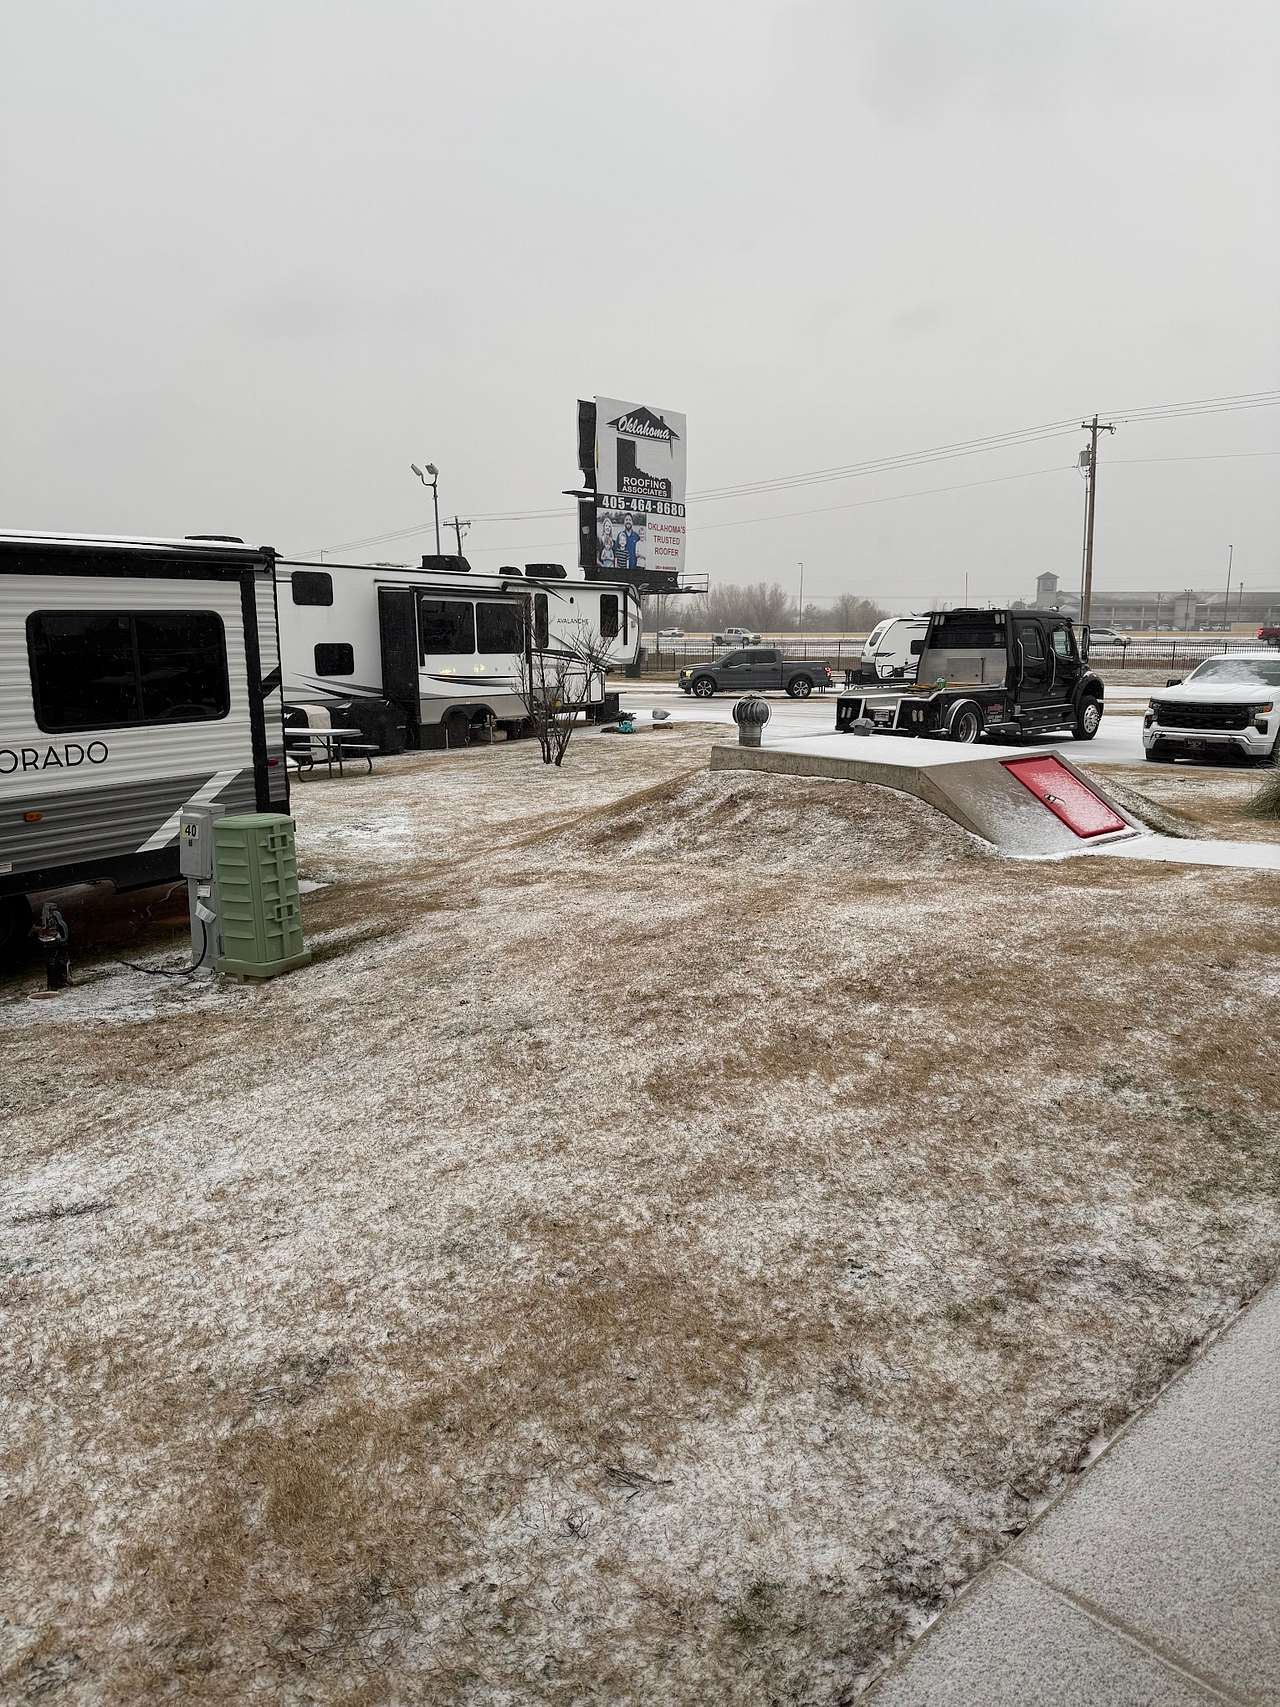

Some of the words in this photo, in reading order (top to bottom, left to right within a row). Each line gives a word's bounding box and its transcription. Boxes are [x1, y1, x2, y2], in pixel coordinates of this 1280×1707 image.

[618, 415, 670, 440] Oklahoma
[623, 476, 667, 490] ROOFING
[622, 485, 667, 497] ASSOCIATES
[602, 495, 684, 516] 405-464-8680
[647, 522, 686, 534] OKLAHOMA'S
[653, 535, 681, 546] TRUSTED
[654, 547, 679, 557] ROOFER
[0, 741, 108, 773] ORADO
[184, 824, 197, 837] 40
